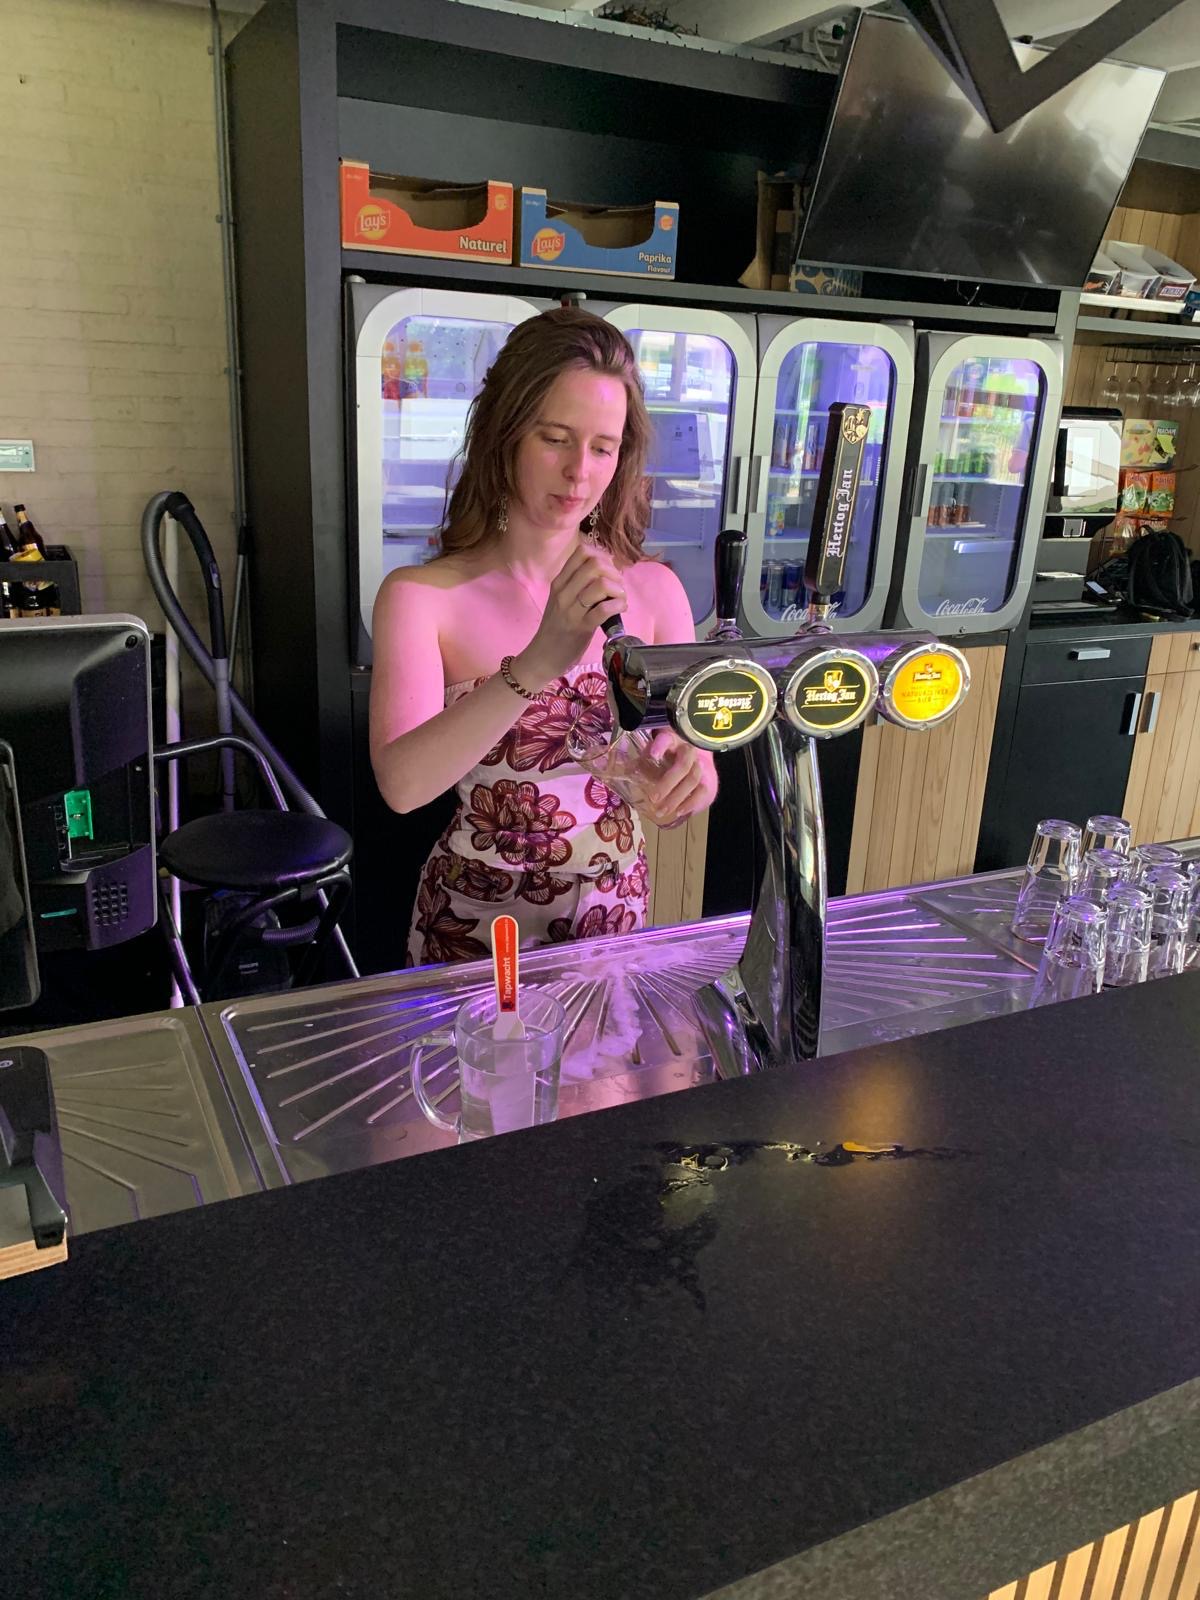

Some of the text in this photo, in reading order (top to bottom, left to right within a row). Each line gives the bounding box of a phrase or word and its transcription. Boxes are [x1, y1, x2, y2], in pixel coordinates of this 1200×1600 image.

[360, 212, 387, 231] Lay's
[459, 235, 507, 253] Naturel
[638, 252, 672, 264] Paprika
[826, 469, 854, 558] Hertog Jan
[804, 688, 857, 705] Hertog Jan
[502, 957, 513, 1000] Tapwacht
